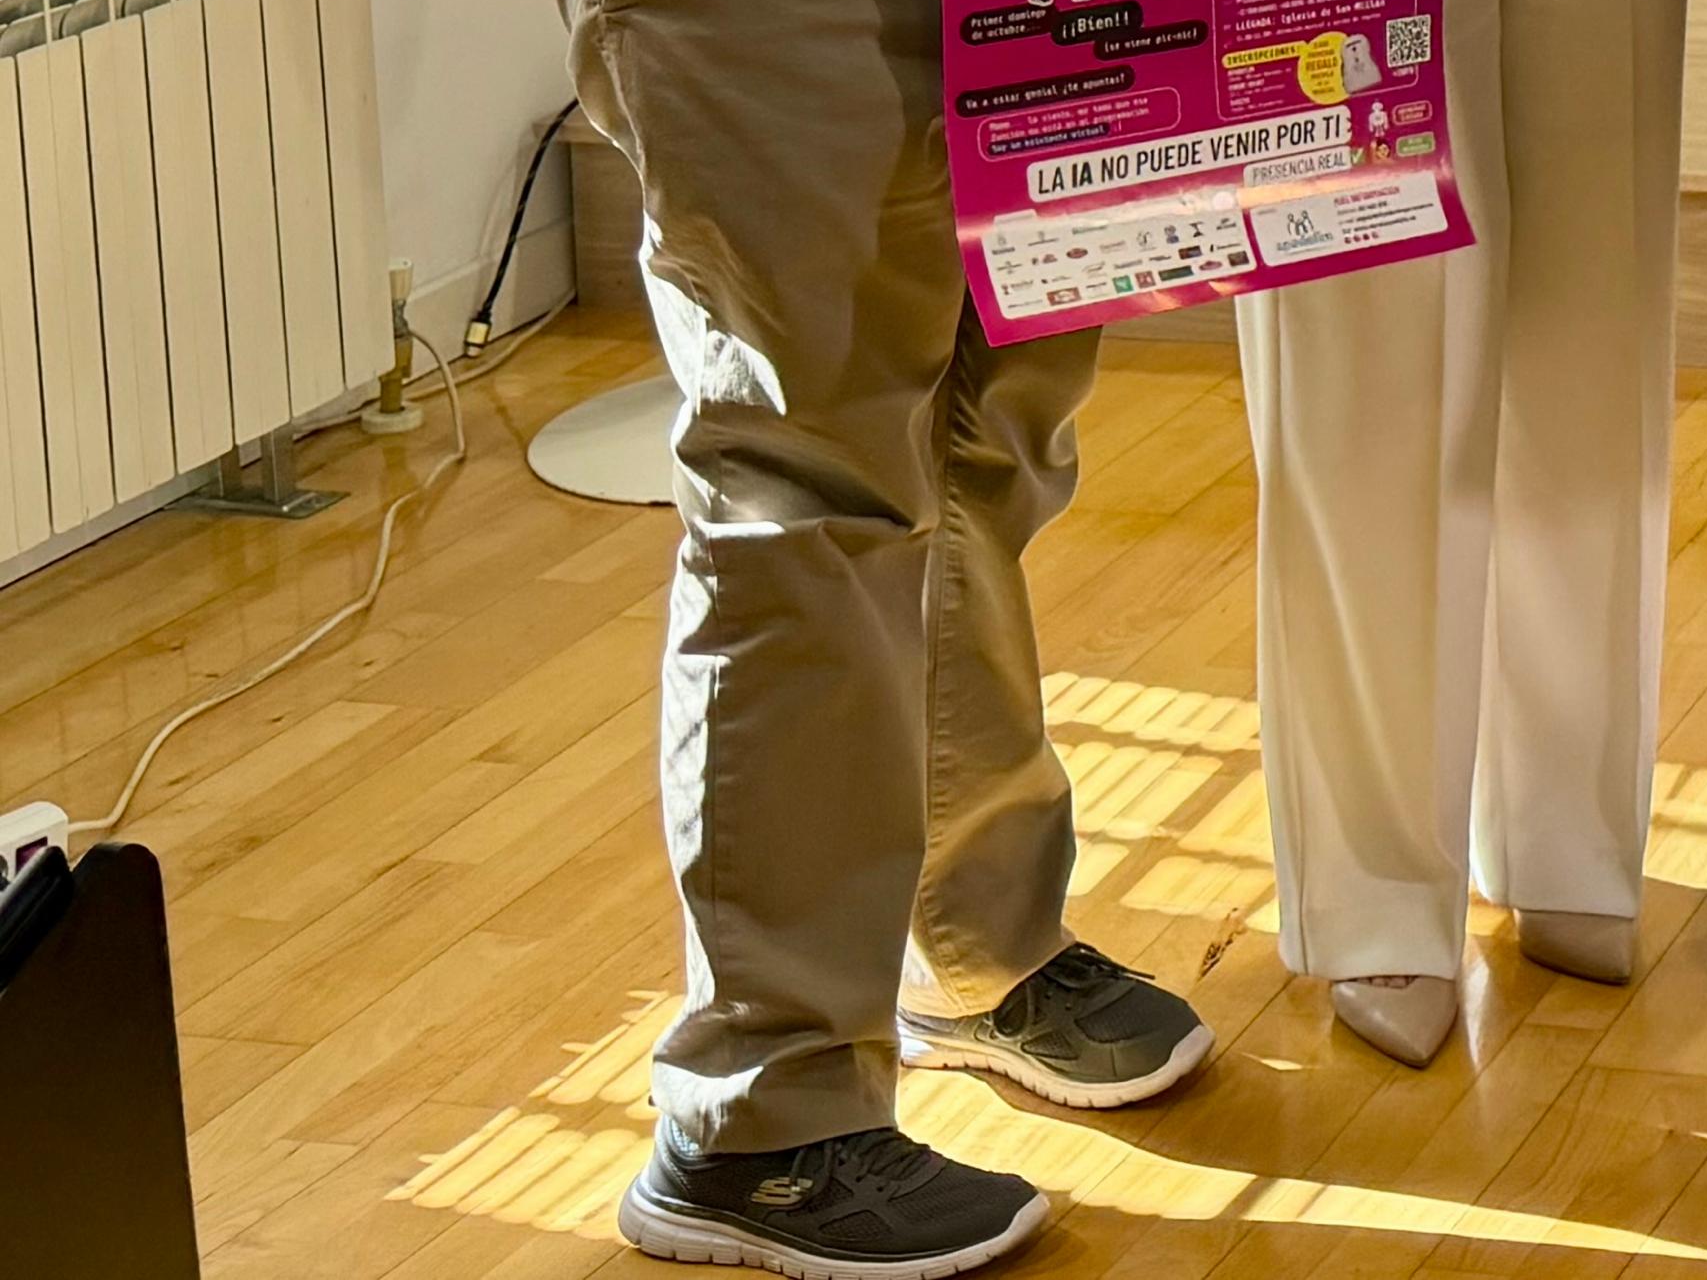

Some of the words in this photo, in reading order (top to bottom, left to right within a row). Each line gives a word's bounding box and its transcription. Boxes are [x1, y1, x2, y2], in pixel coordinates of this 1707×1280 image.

[1037, 165, 1064, 196] LA
[1071, 162, 1093, 189] IA
[1100, 156, 1129, 184] NO
[1135, 143, 1202, 177] PUEDE
[1209, 133, 1269, 166] VENIR
[1276, 123, 1316, 155] POR
[1323, 115, 1342, 143] TI
